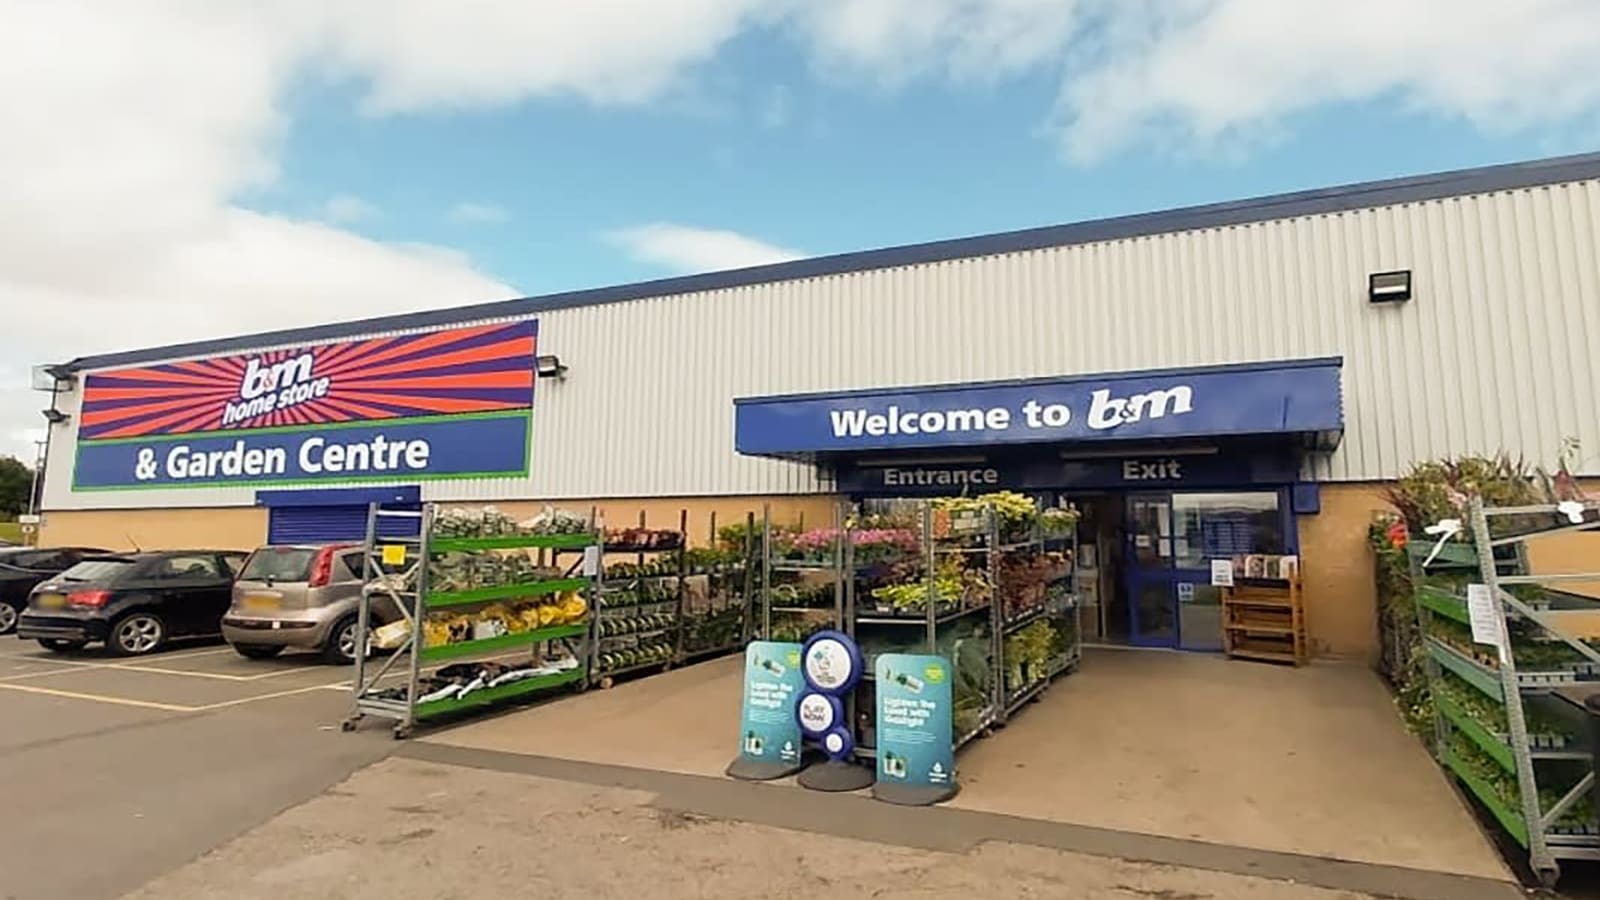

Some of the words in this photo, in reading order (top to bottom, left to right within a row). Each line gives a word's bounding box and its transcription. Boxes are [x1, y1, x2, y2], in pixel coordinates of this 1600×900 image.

[241, 354, 313, 399] b&m
[222, 394, 277, 424] home
[277, 377, 330, 408] store
[830, 406, 1010, 437] Welcome
[1022, 400, 1071, 428] to
[1088, 385, 1193, 430] b&m
[136, 448, 157, 480] &
[167, 440, 286, 478] Garden
[299, 434, 429, 473] Centre
[883, 468, 998, 485] Entrance
[1123, 459, 1182, 480] Exit
